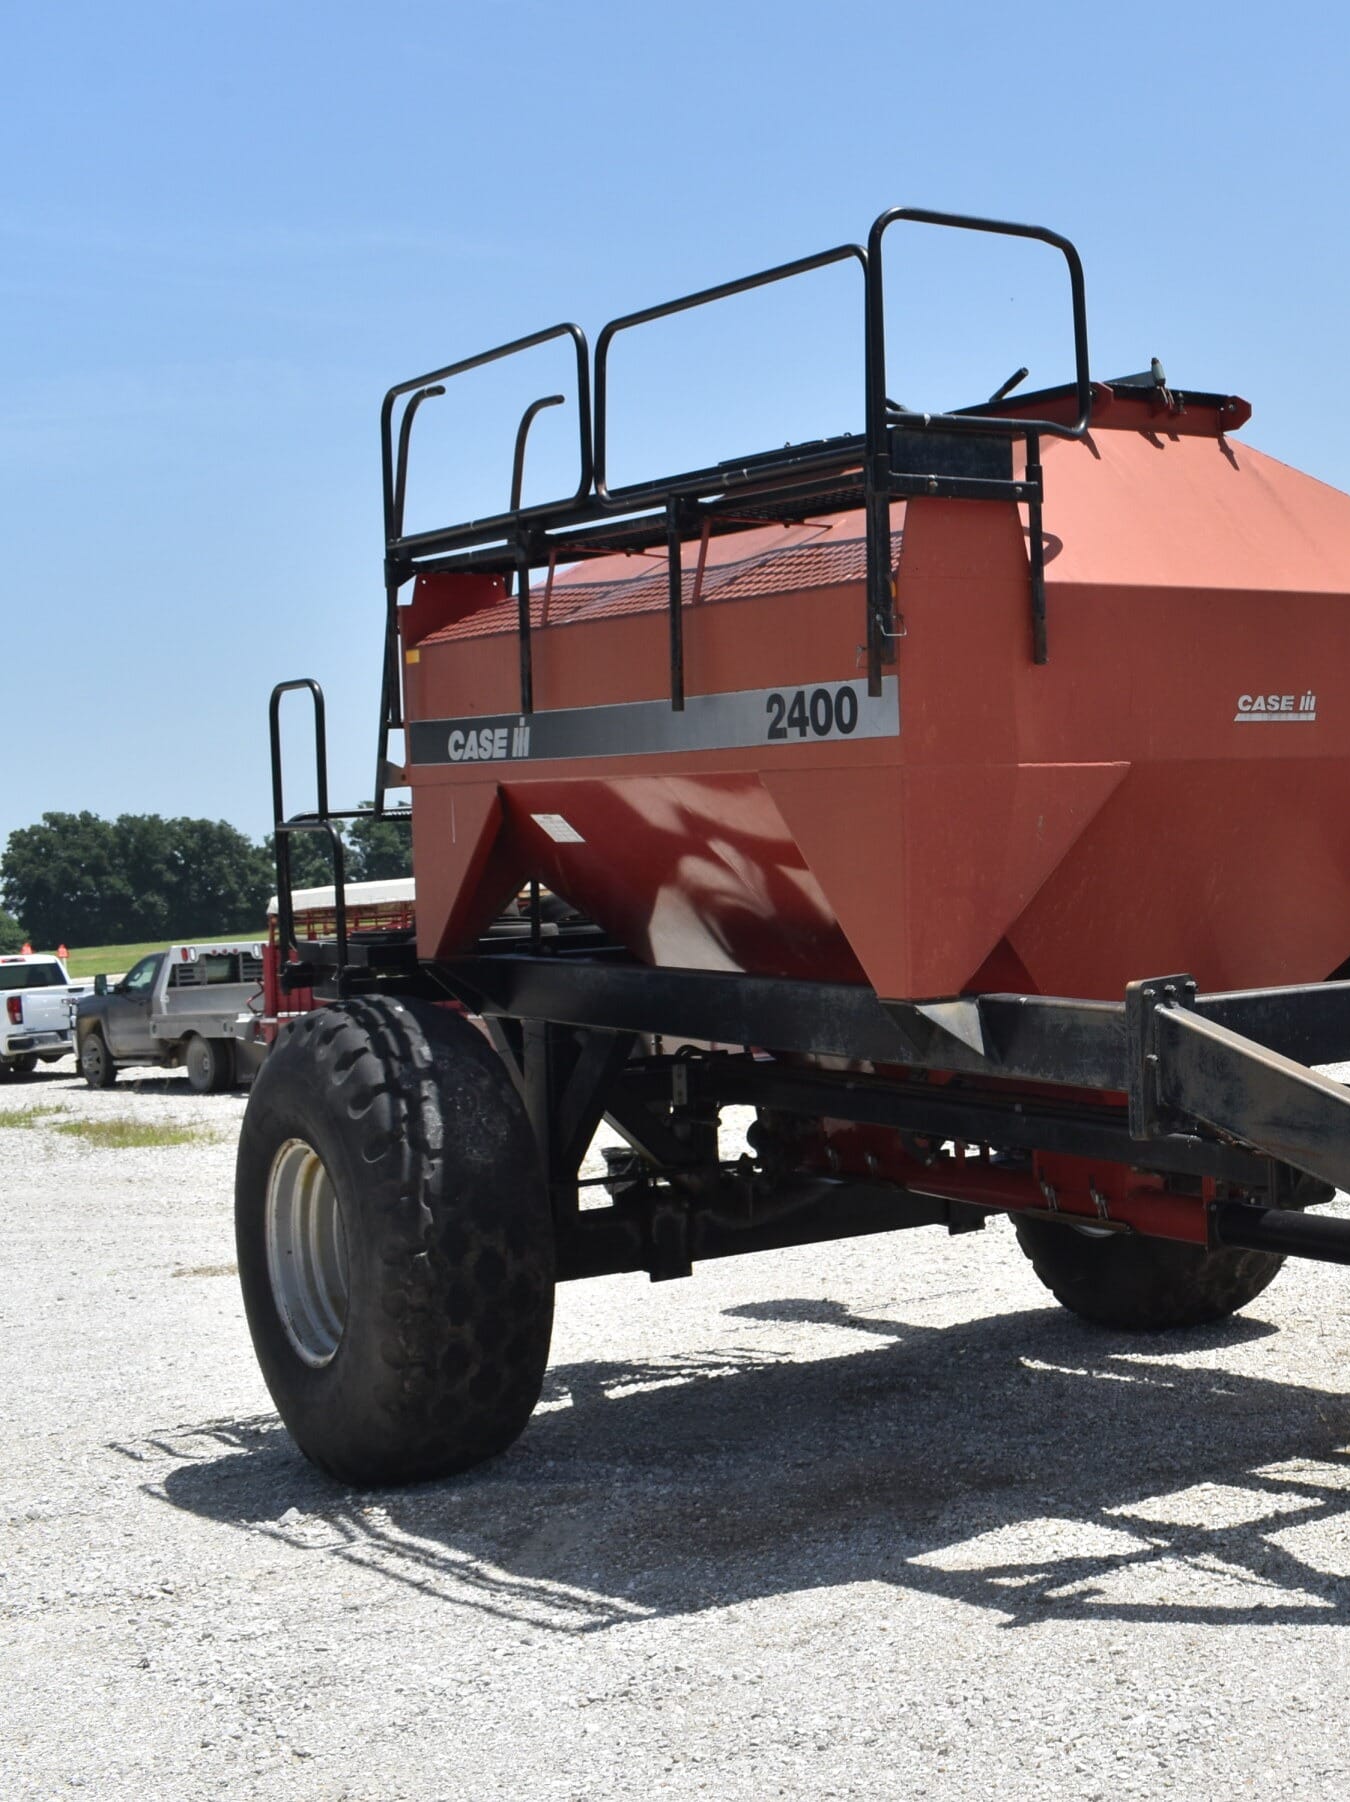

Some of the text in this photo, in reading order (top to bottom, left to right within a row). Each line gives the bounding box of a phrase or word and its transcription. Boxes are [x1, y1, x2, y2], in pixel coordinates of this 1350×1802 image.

[766, 685, 858, 740] 2400
[1237, 694, 1295, 712] CASE
[447, 728, 508, 761] CASE
